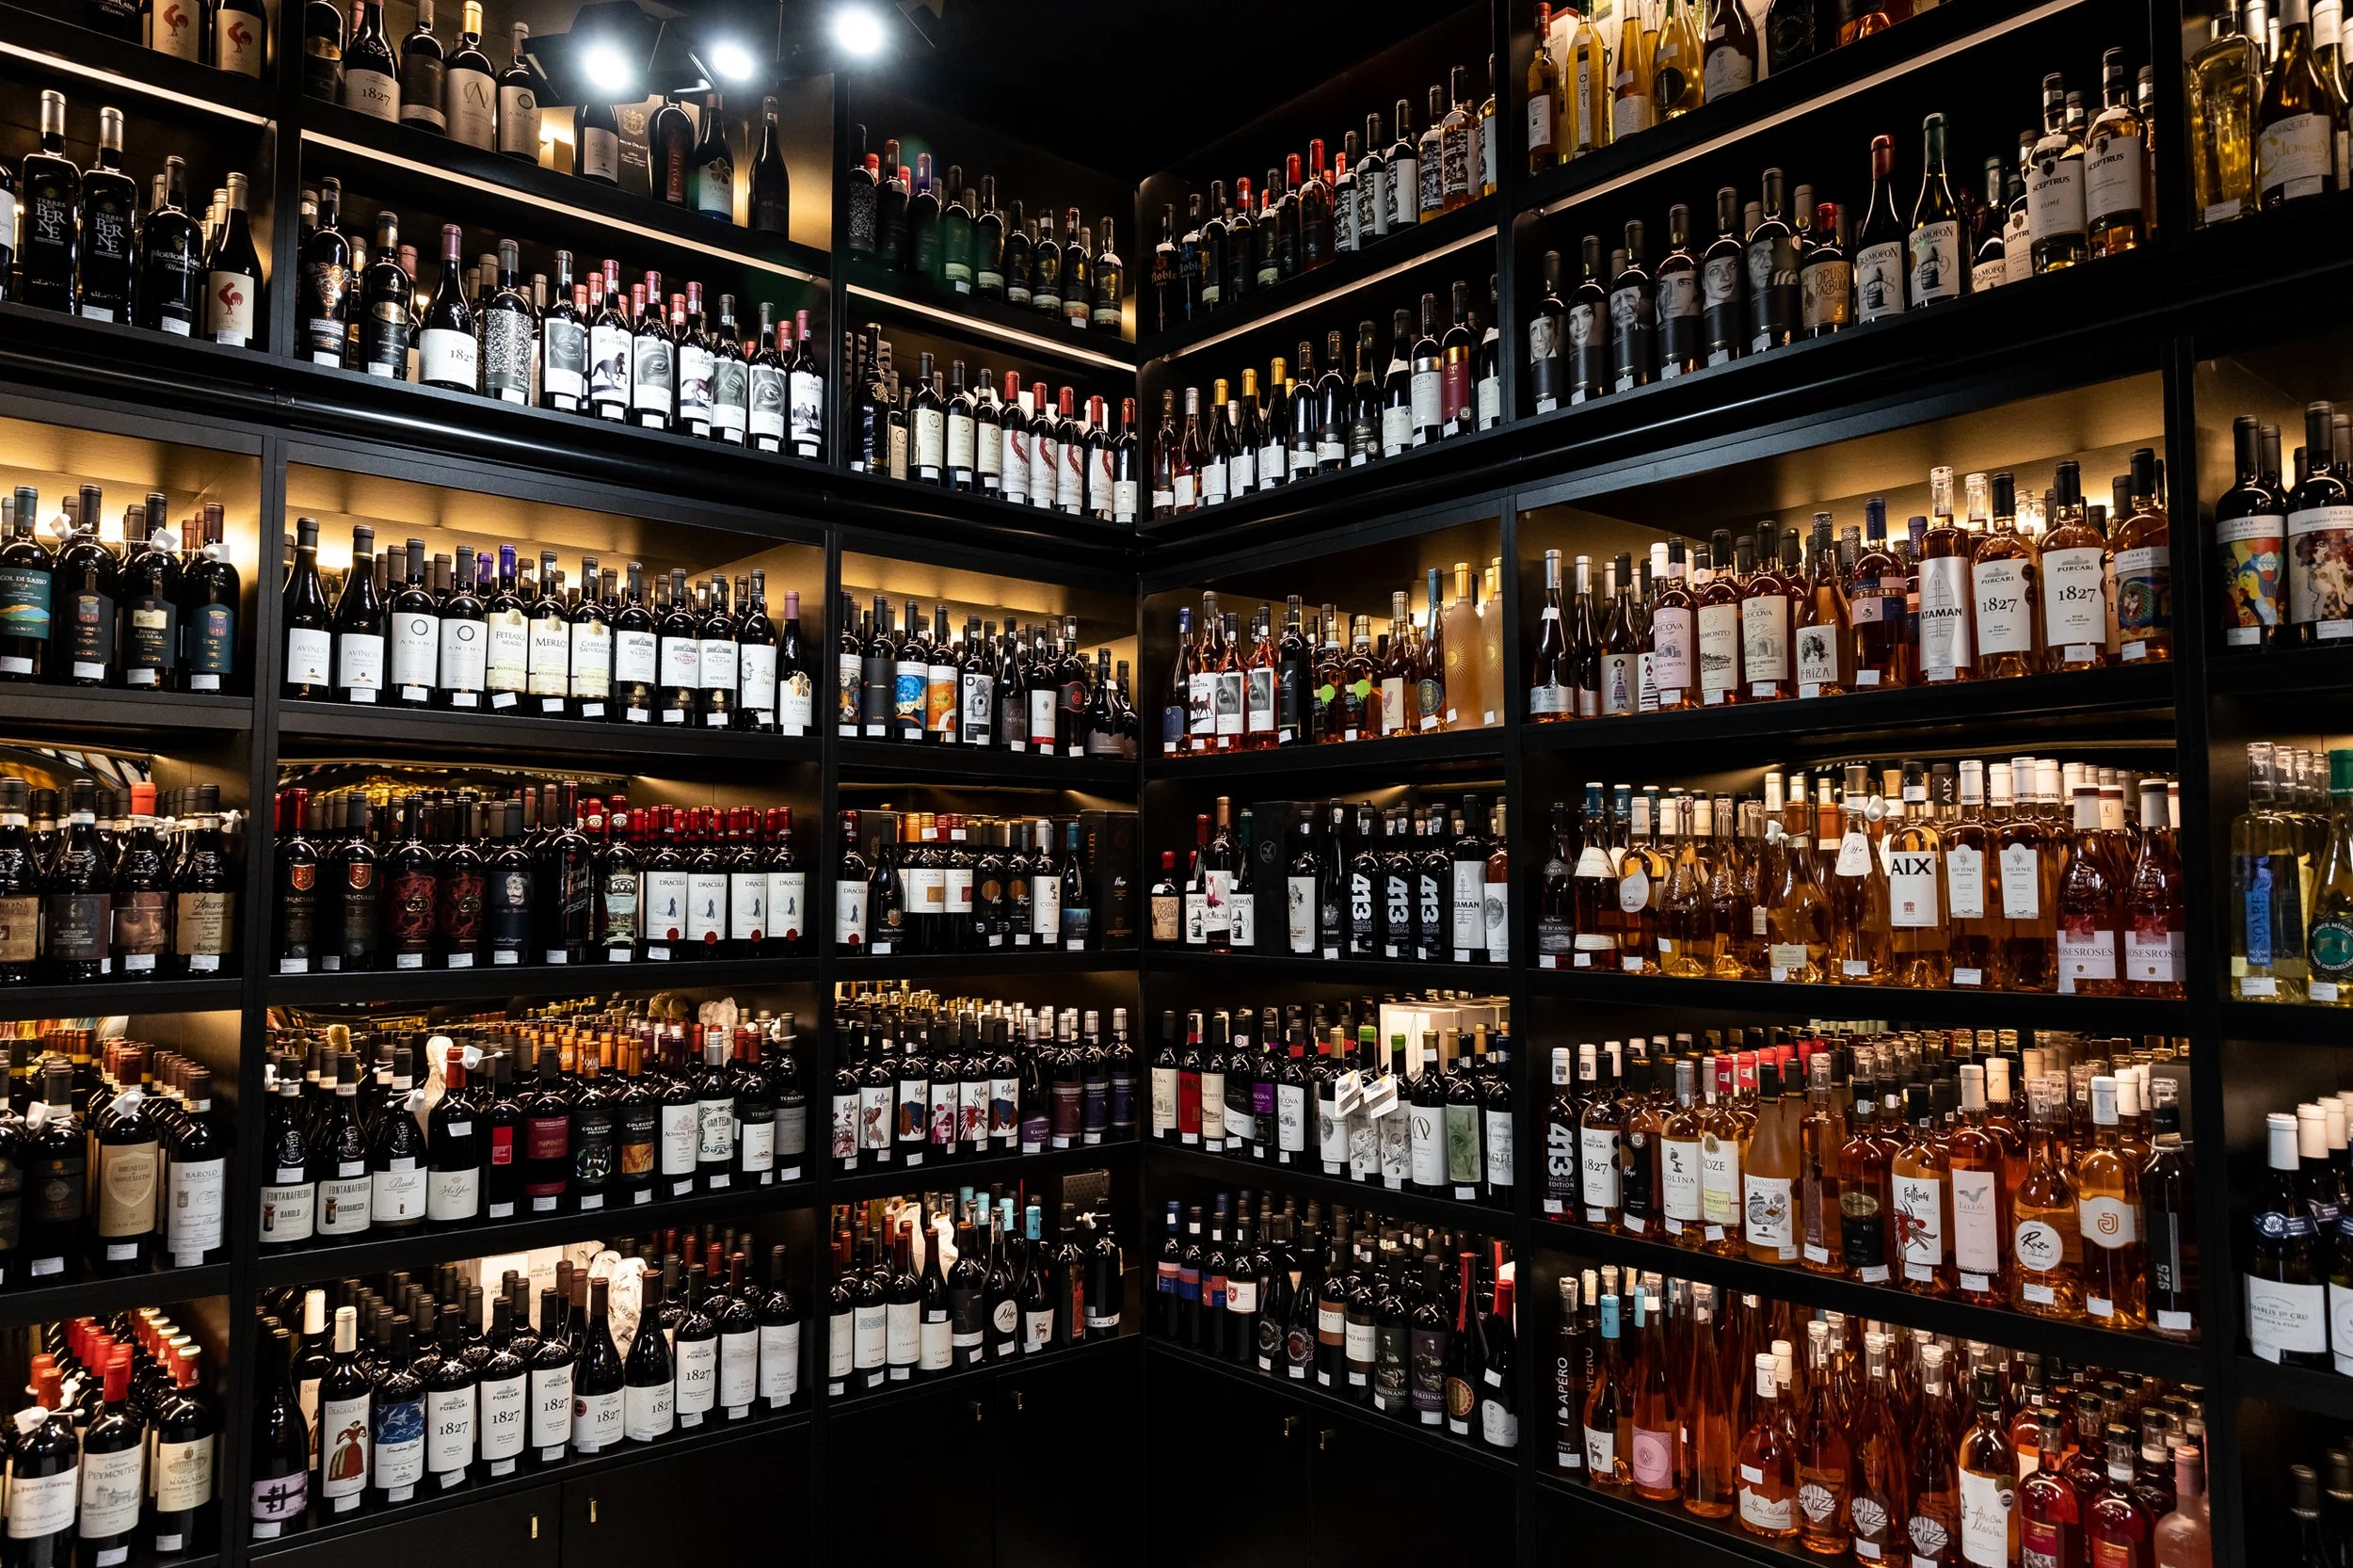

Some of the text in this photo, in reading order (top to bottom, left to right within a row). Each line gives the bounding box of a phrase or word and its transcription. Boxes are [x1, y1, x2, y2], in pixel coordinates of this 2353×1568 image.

[361, 87, 391, 106] 1827
[2087, 152, 2124, 172] SCEPTRUS
[2031, 176, 2071, 193] SCEPTRUS
[37, 197, 66, 208] TERRES
[1981, 576, 2014, 584] PURCARI
[2058, 585, 2096, 602] 1827
[1982, 598, 2018, 613] 1827
[1921, 608, 1961, 620] ATAMAN
[1943, 776, 1953, 803] AIX
[1891, 857, 1932, 875] AIX
[615, 880, 633, 891] 555
[1352, 873, 1372, 920] 413
[1386, 875, 1409, 923] 413
[1419, 874, 1439, 923] 413
[2249, 955, 2269, 964] NOIR
[706, 1119, 717, 1128] SAN
[1548, 1123, 1574, 1176] 413
[1583, 1141, 1607, 1149] PURCARI
[1584, 1159, 1609, 1175] 1827
[184, 1169, 218, 1180] BAROLO
[389, 1176, 415, 1188] Barolo
[1904, 1183, 1929, 1204] Folklore
[280, 1208, 300, 1218] BAROLO
[685, 1369, 712, 1382] 1827
[1559, 1356, 1570, 1404] APÉRO
[544, 1379, 569, 1388] PURCARI
[492, 1390, 520, 1400] PURCARI
[440, 1402, 468, 1411] PURCARI
[543, 1398, 569, 1412] 1827
[491, 1410, 520, 1424] 1827
[597, 1409, 621, 1422] 1827
[439, 1421, 469, 1435] 1827
